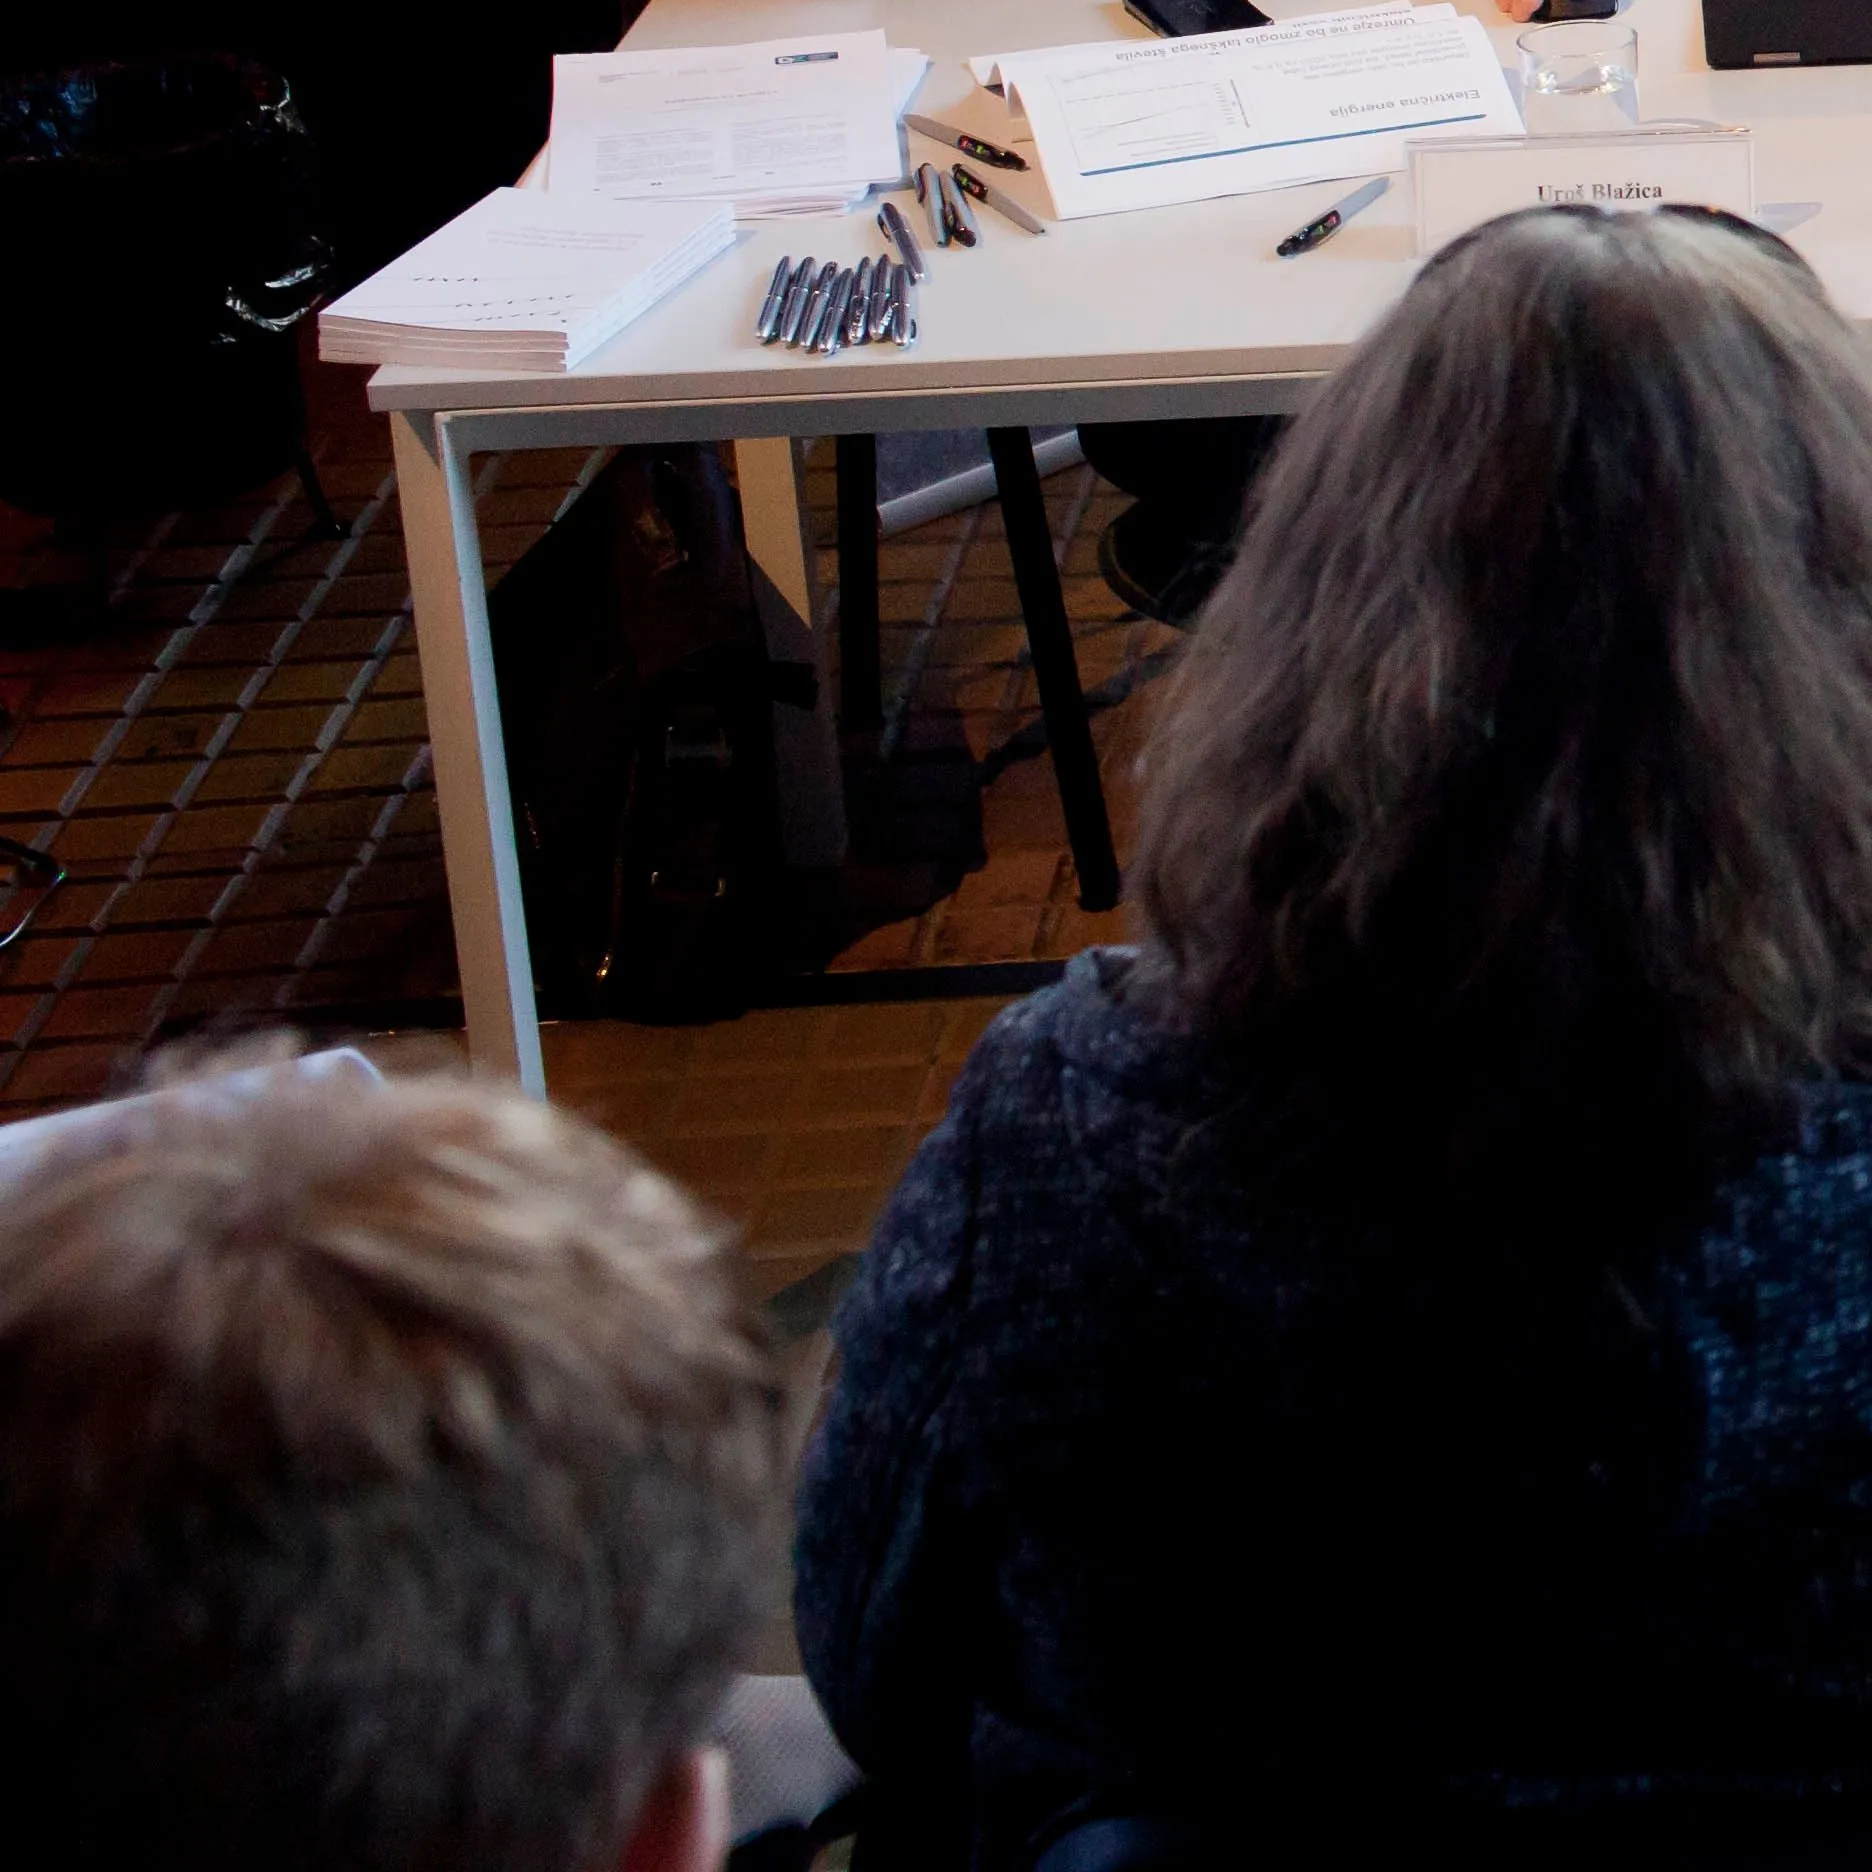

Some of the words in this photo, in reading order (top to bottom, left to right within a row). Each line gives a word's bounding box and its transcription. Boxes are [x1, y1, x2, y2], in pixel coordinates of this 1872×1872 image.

[1399, 89, 1481, 108] Električna
[1329, 100, 1395, 118] energija
[1538, 184, 1585, 203] Uroš
[1592, 181, 1664, 202] Blažica
